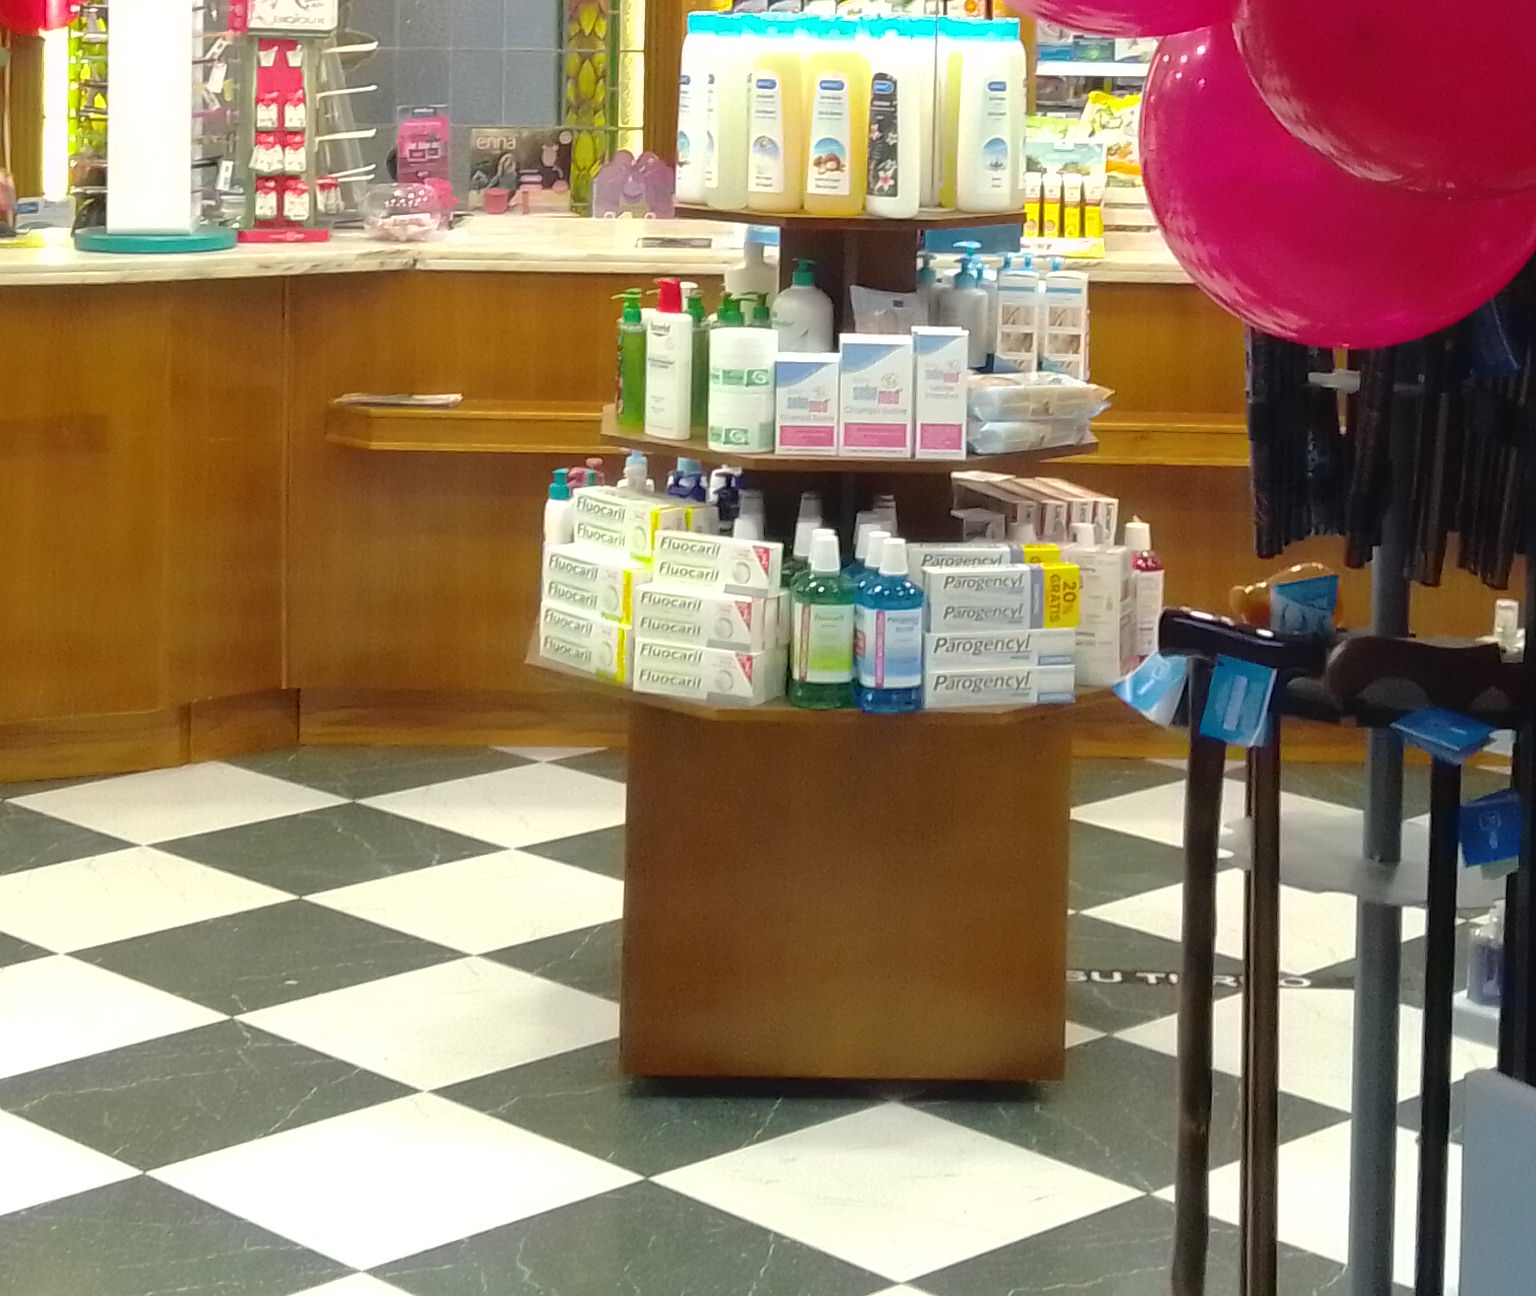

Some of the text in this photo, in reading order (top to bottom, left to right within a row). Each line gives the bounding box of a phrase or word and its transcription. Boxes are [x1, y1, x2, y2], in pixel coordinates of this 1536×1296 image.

[576, 496, 626, 521] Fluocaril
[577, 524, 625, 547] Fluocaril
[659, 537, 721, 556] Fluocaril
[548, 554, 599, 581] Fluocaril
[659, 563, 719, 582] Fluocaril
[943, 574, 1023, 591] Parogencyl
[548, 583, 597, 608] Fluocaril
[640, 591, 703, 611] Fluocaril
[1049, 574, 1061, 623] GRATIS
[544, 608, 593, 636] Fluocaril
[943, 603, 1023, 621] Parogencyl
[640, 617, 701, 636] Fluocaril
[544, 636, 592, 663] Fluocaril
[640, 643, 703, 663] Fluocaril
[933, 634, 1031, 655] Parogencyl
[639, 669, 701, 689] Fluocaril
[933, 671, 1031, 692] Parogencyl
